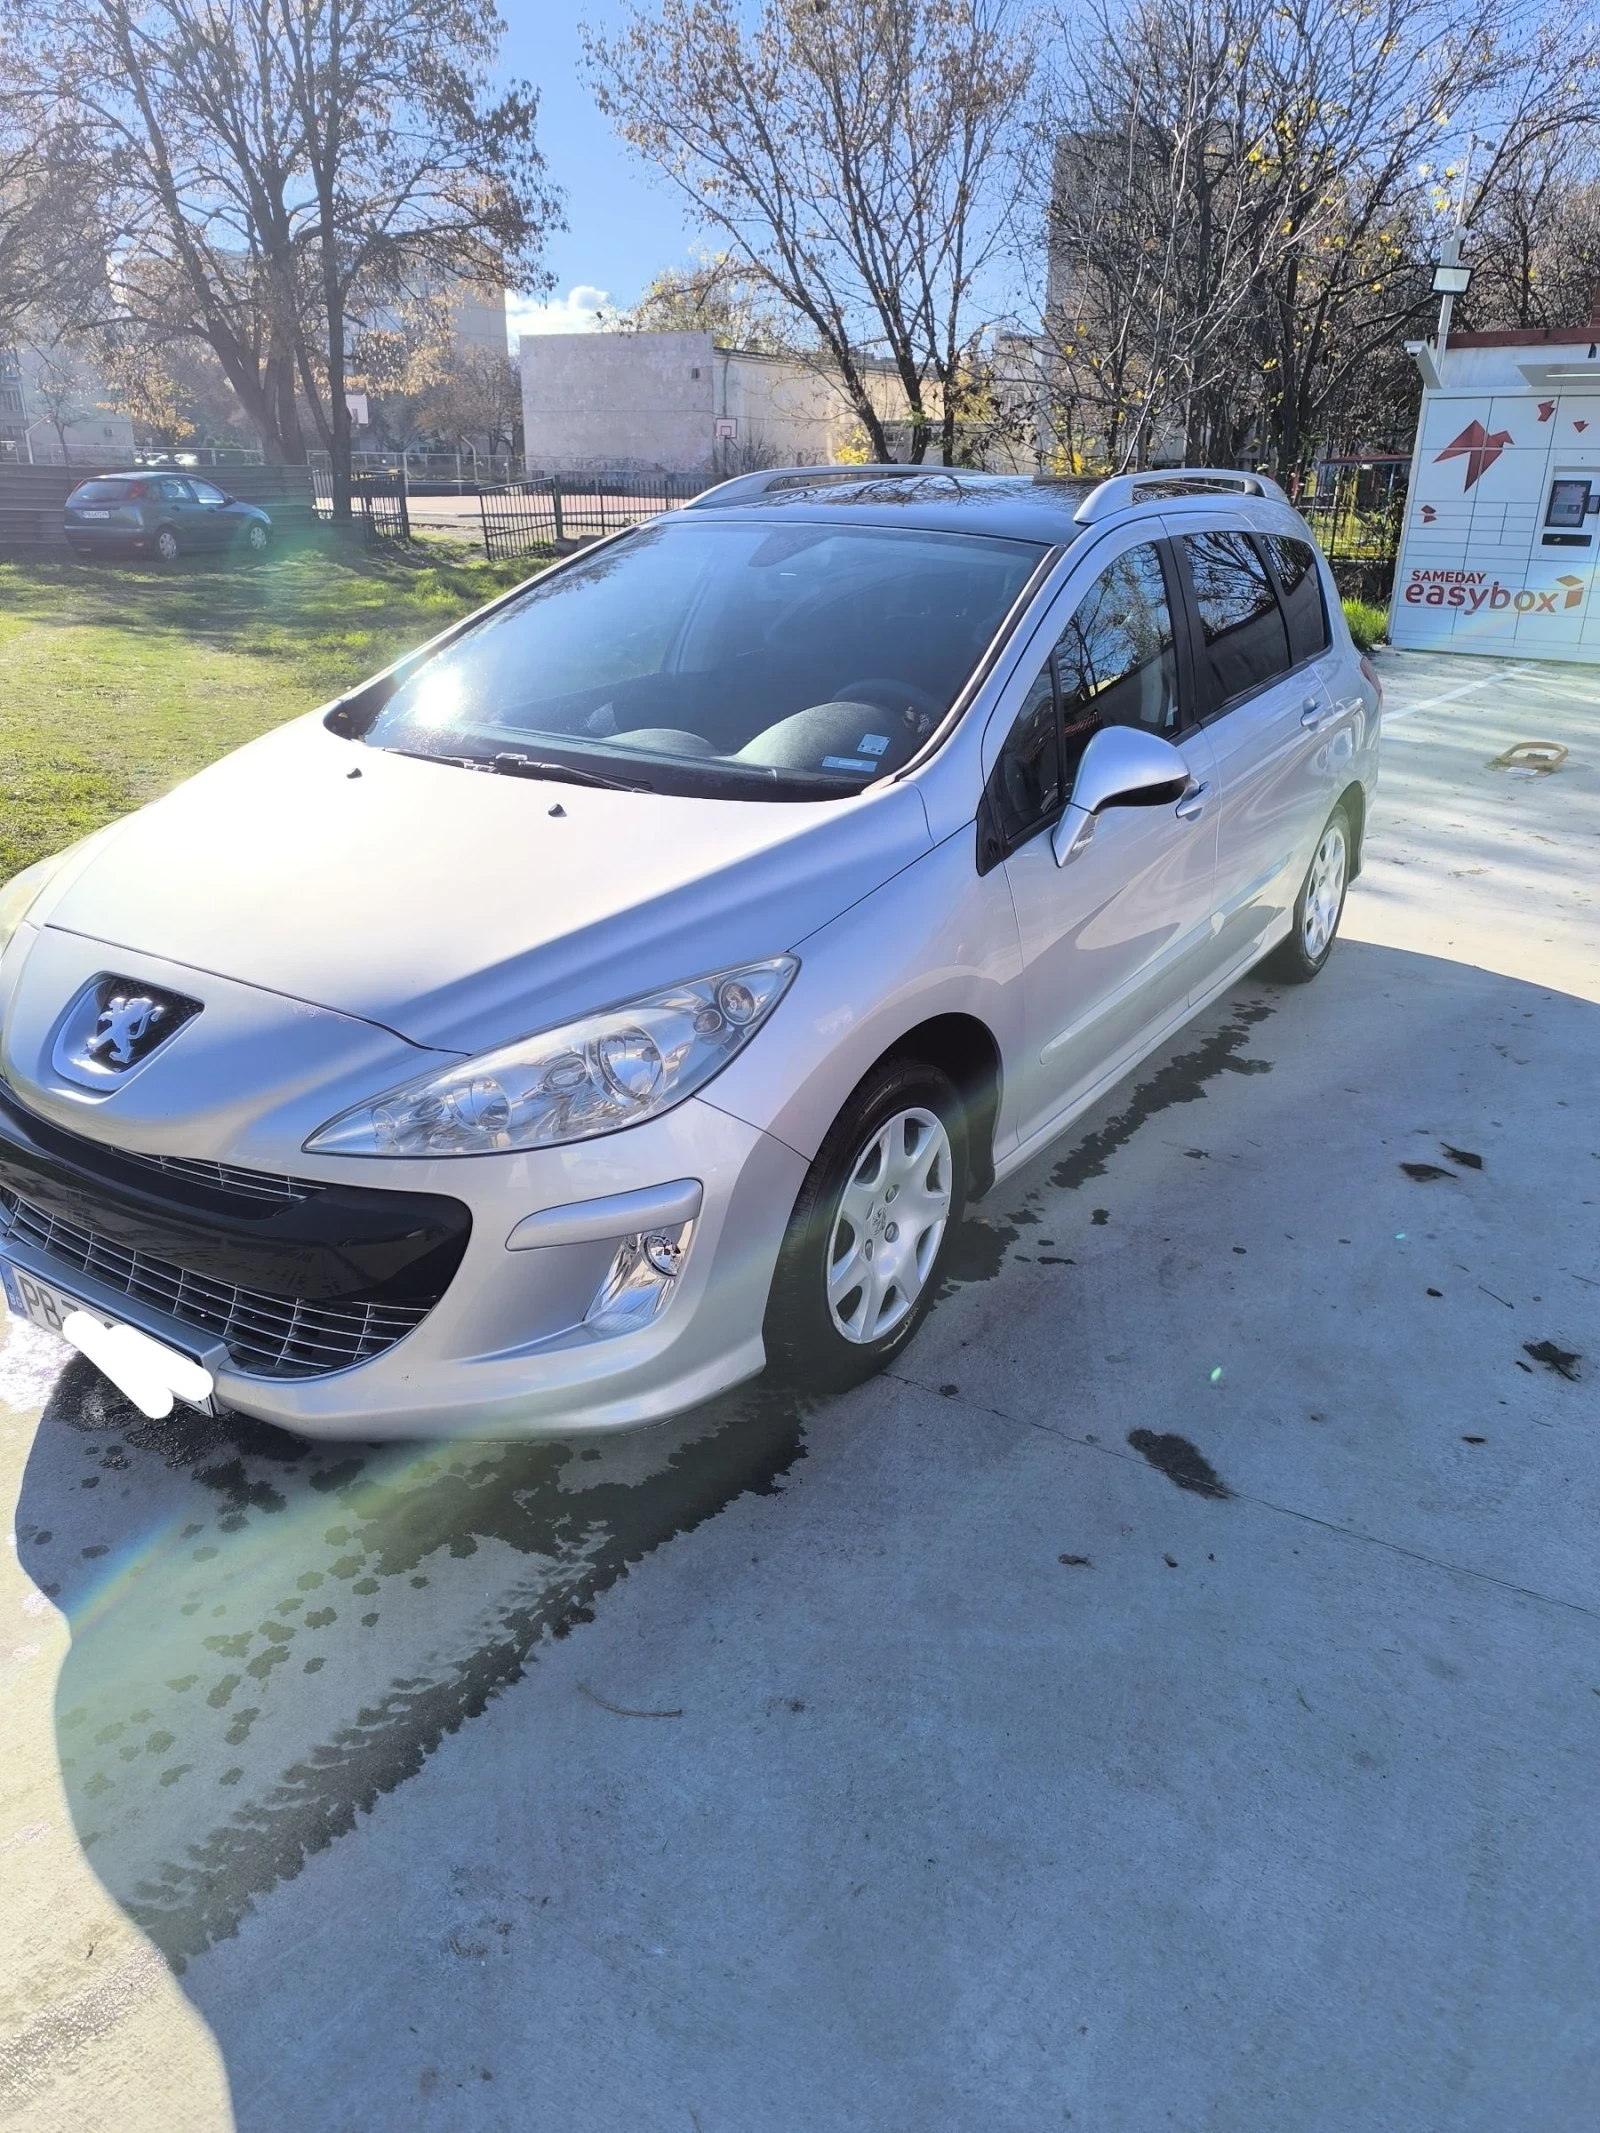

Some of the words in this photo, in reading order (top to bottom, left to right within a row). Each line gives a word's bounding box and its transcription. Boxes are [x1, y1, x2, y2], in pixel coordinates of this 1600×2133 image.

[1411, 570, 1487, 584] SAMEDAY
[1405, 581, 1560, 615] easybox
[8, 1293, 23, 1309] BG
